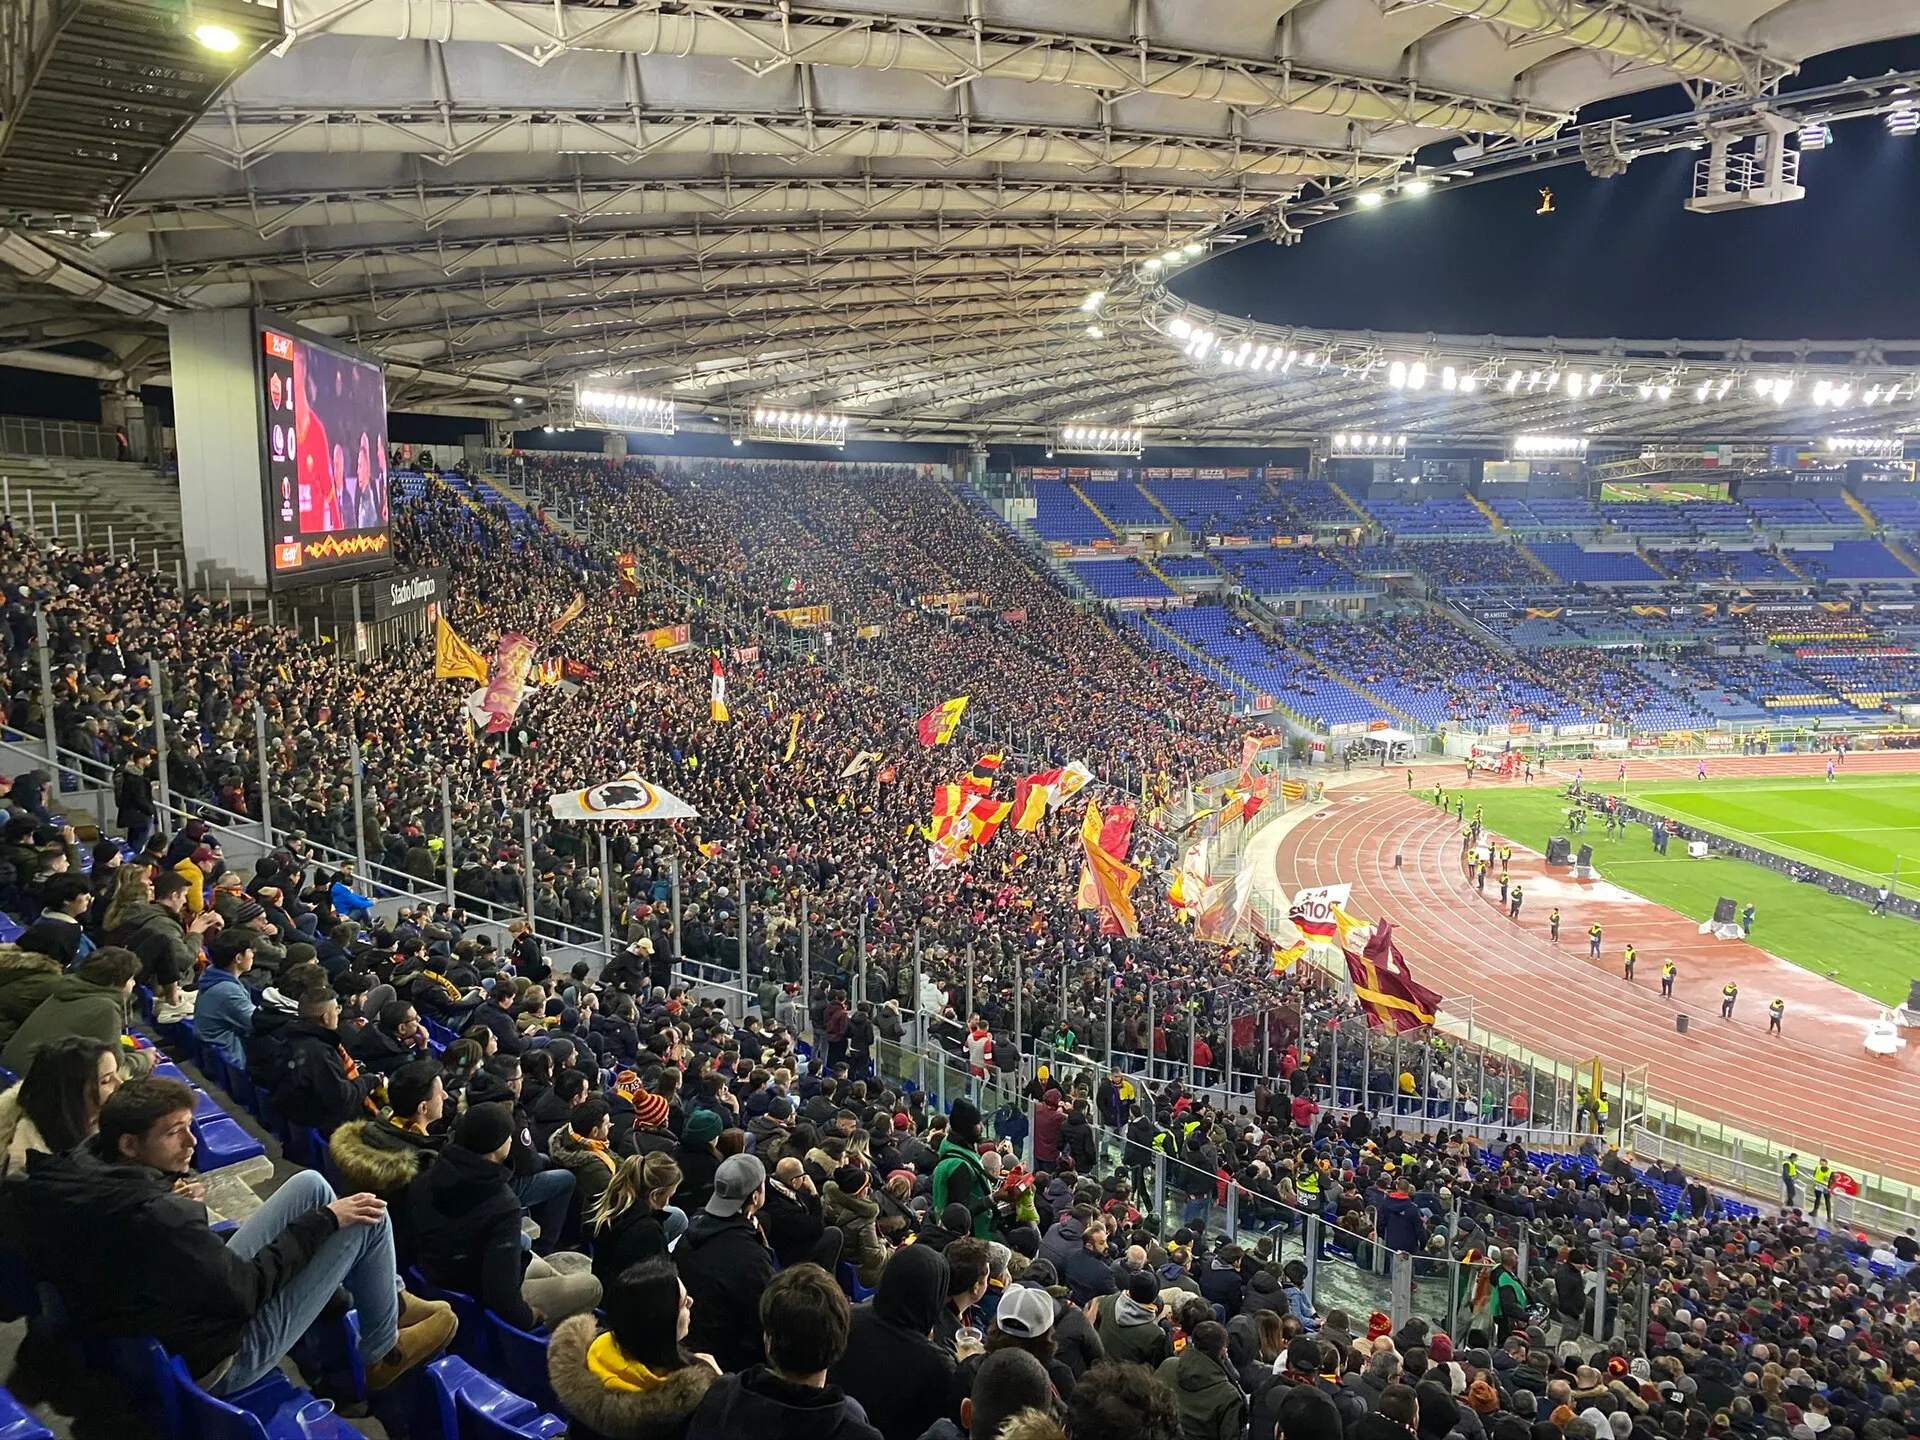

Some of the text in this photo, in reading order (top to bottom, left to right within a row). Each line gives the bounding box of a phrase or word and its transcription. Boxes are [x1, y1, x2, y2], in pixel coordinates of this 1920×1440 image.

[285, 376, 294, 410] 1
[287, 426, 296, 461] 0
[391, 574, 435, 606] Stadio Olimpico
[1298, 1191, 1317, 1201] WARD
